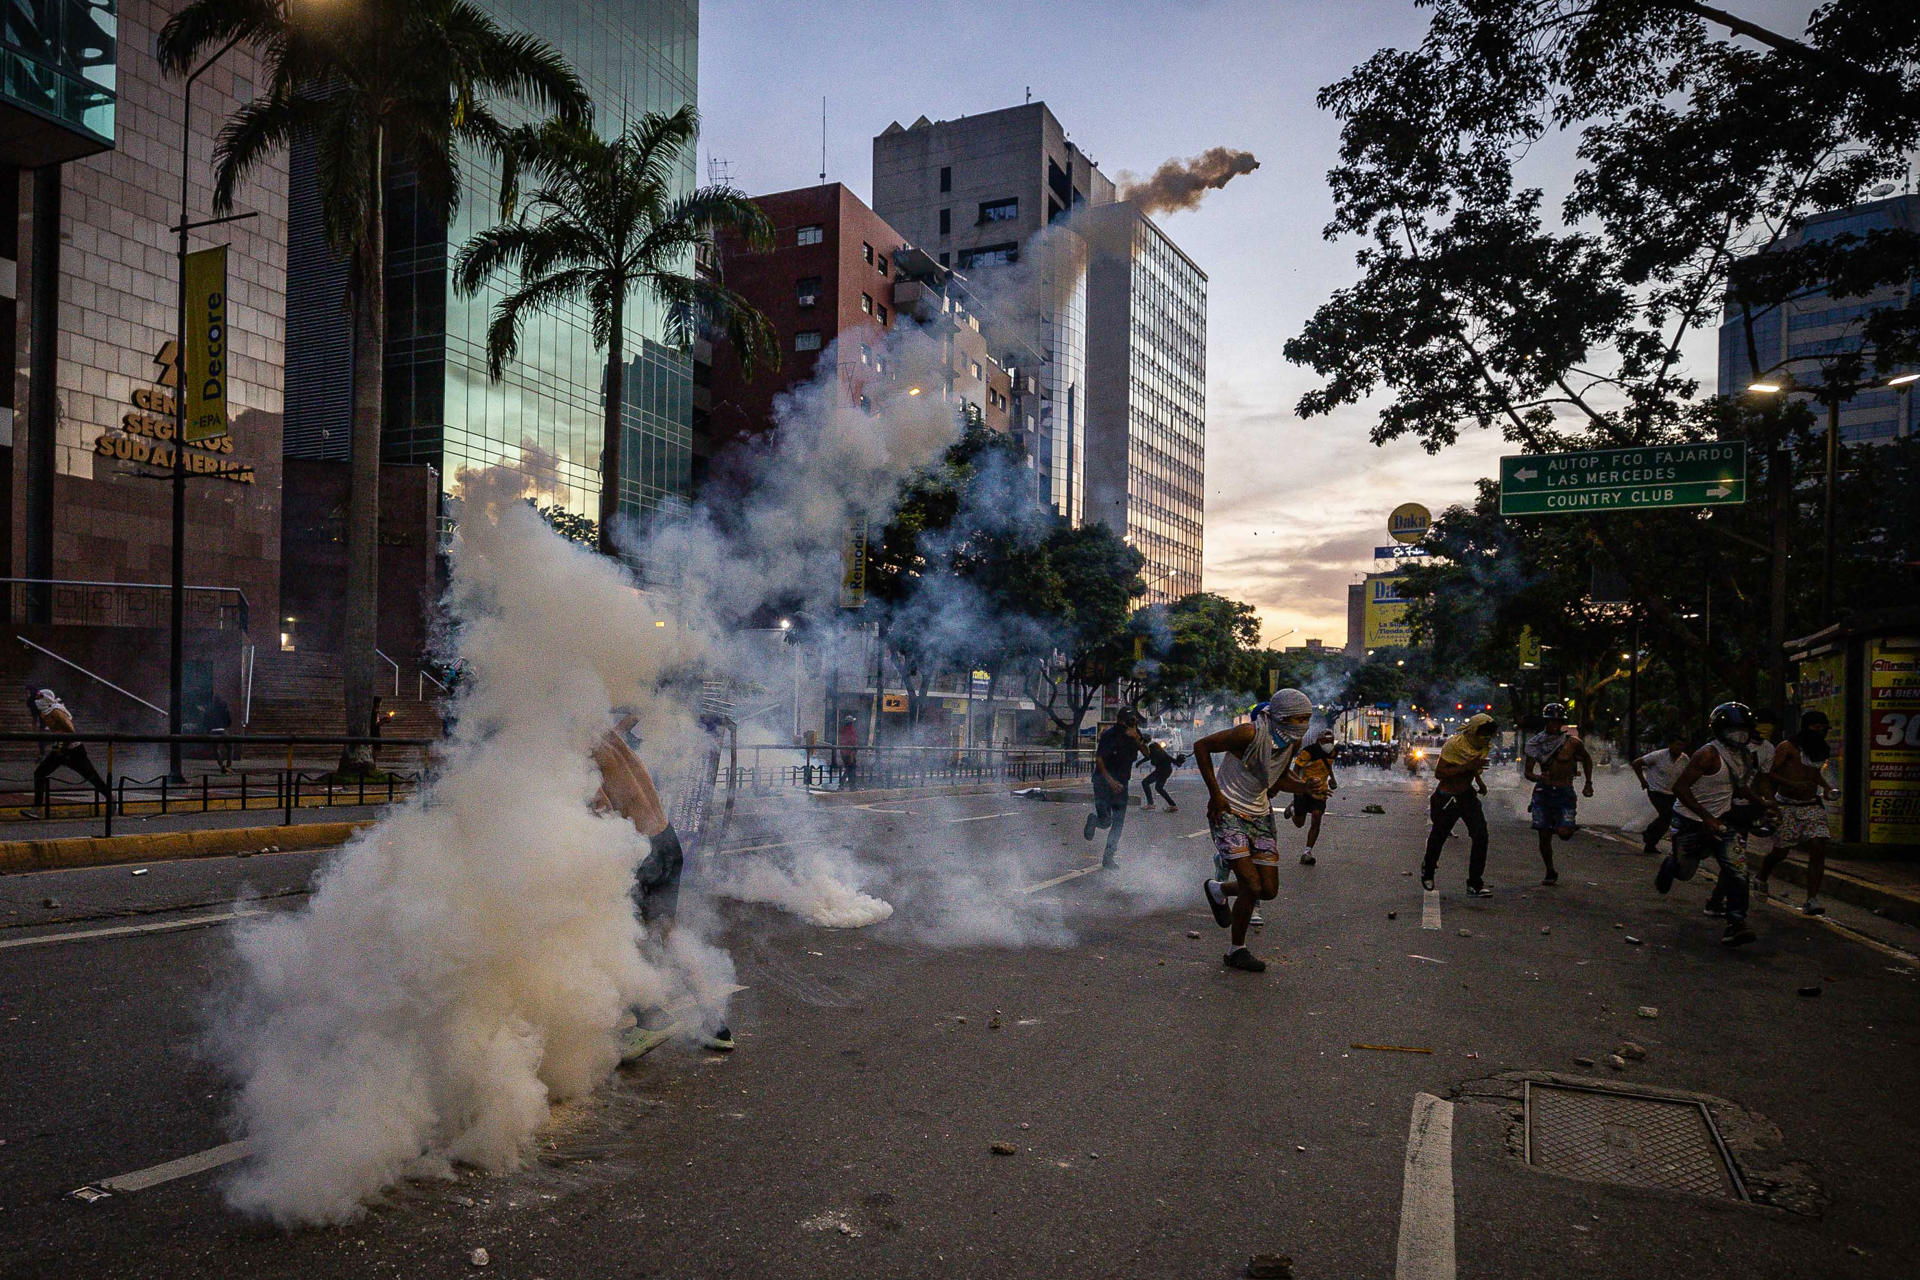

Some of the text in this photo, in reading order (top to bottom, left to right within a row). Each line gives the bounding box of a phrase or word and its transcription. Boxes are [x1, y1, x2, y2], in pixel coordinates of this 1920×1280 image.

[203, 292, 222, 400] Decore
[199, 413, 221, 427] EPA
[1548, 457, 1605, 471] AUTOP.
[1656, 447, 1734, 464] FAJARDO
[1547, 467, 1677, 487] LAS MERCEDES
[1547, 489, 1676, 507] COUNTRY CLUB
